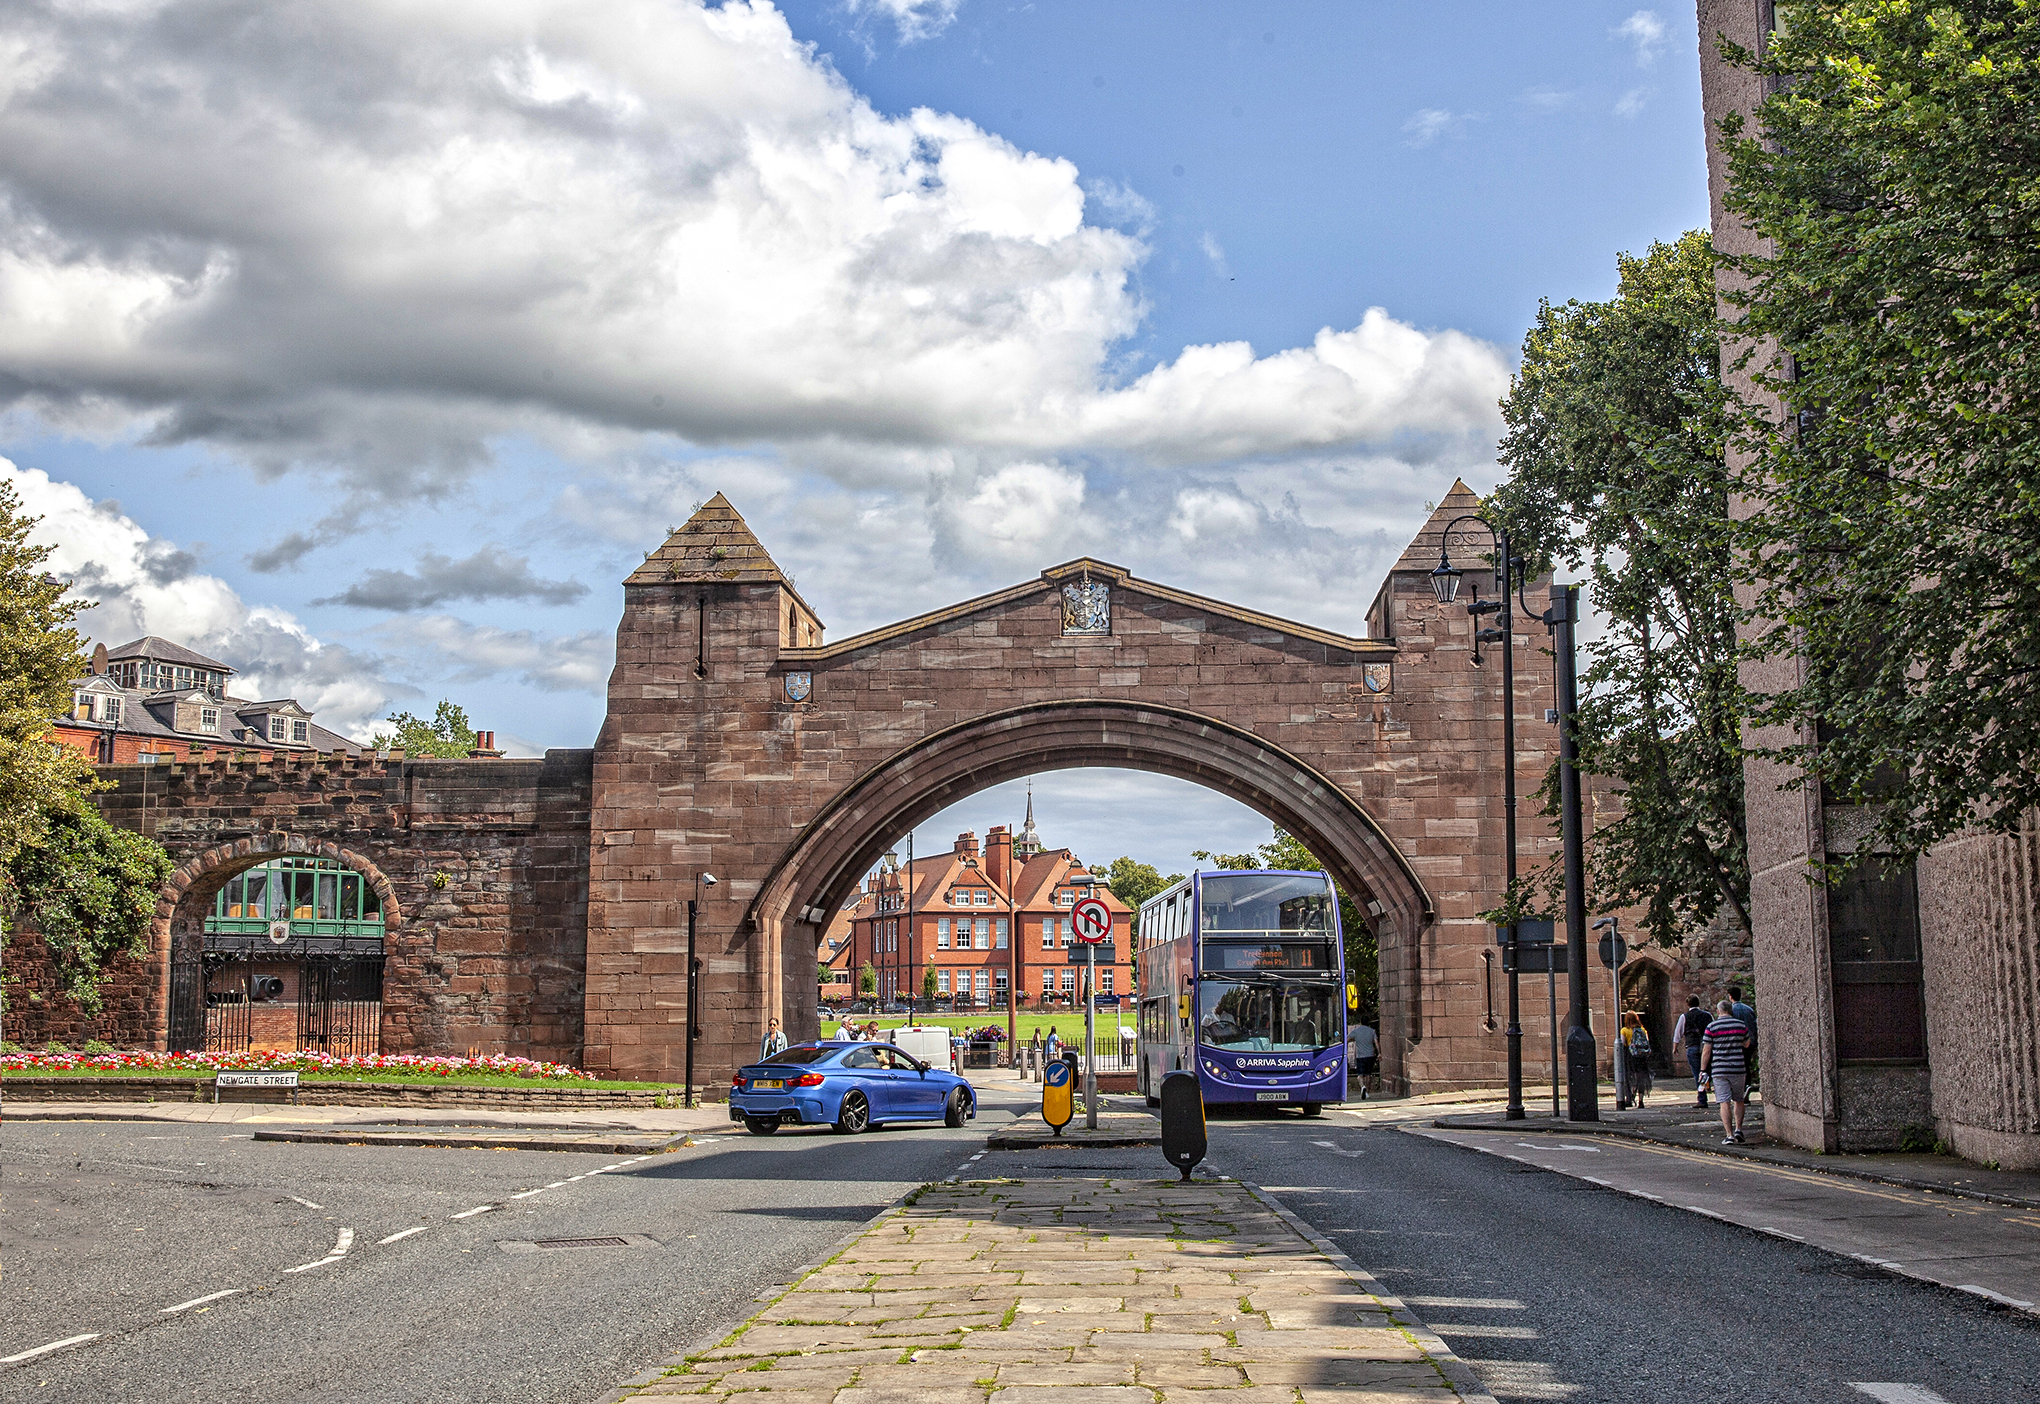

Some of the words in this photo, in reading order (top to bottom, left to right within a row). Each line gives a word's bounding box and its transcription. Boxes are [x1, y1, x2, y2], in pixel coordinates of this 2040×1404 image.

[1301, 949, 1313, 967] 11
[1246, 1058, 1277, 1067] ARRIVA
[1277, 1058, 1310, 1068] Sapphire
[219, 1076, 259, 1085] NEWGATE
[263, 1076, 296, 1085] STREET
